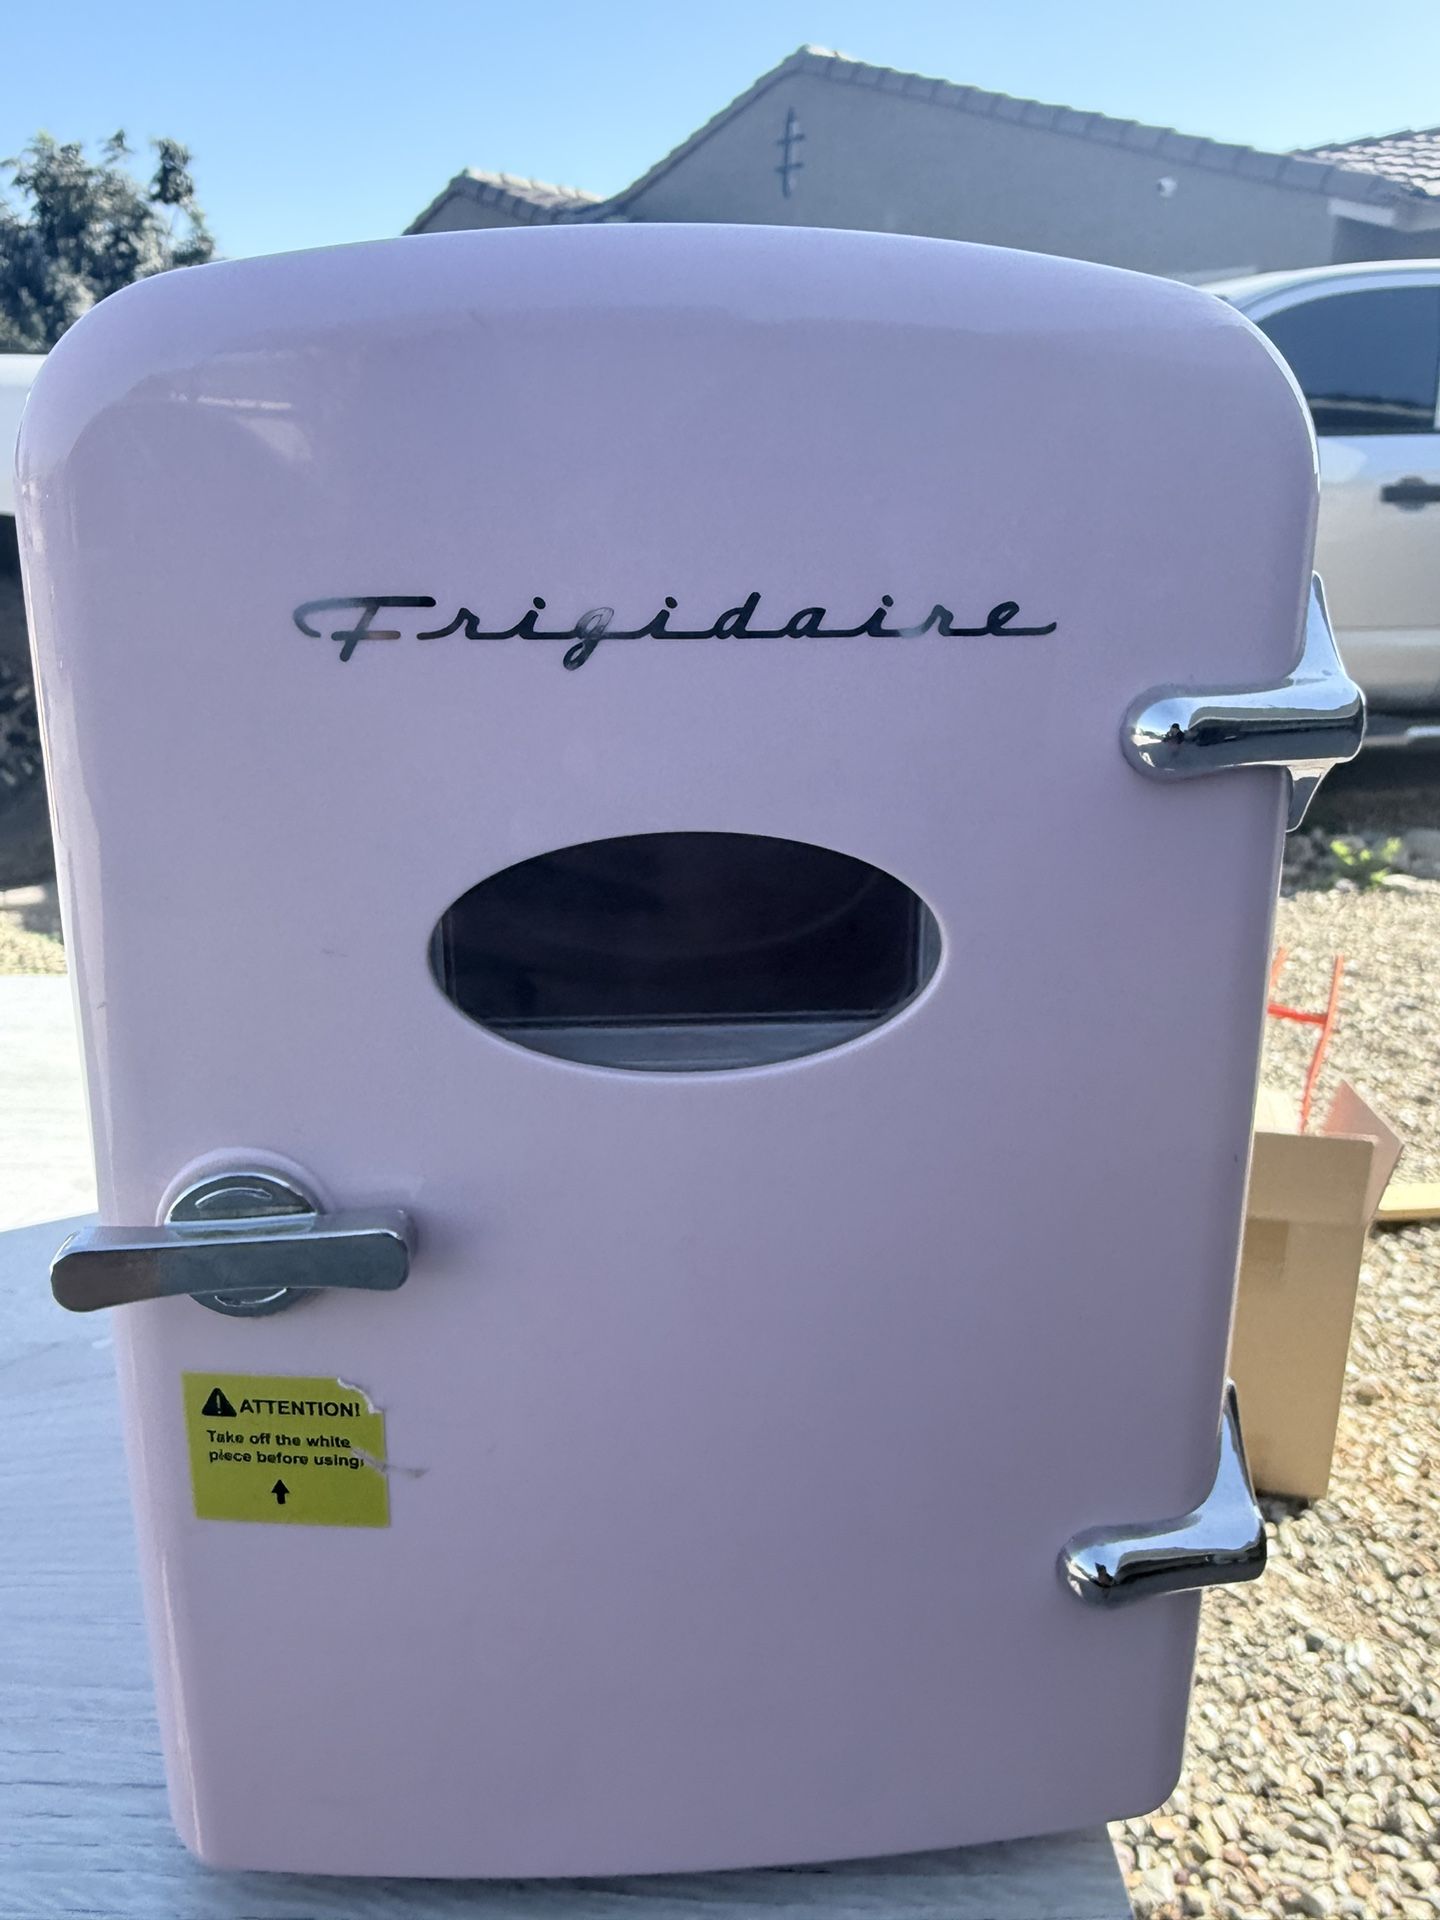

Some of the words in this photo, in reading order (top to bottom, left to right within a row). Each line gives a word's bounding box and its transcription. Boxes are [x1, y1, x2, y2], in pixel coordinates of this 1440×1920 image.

[293, 592, 1057, 671] Frigidaire
[239, 1399, 361, 1417] ATTENTION!
[206, 1430, 244, 1443] Take
[249, 1432, 271, 1445] off
[276, 1434, 301, 1446] the
[306, 1435, 351, 1448] white
[209, 1450, 251, 1463] piece
[256, 1451, 309, 1465] before
